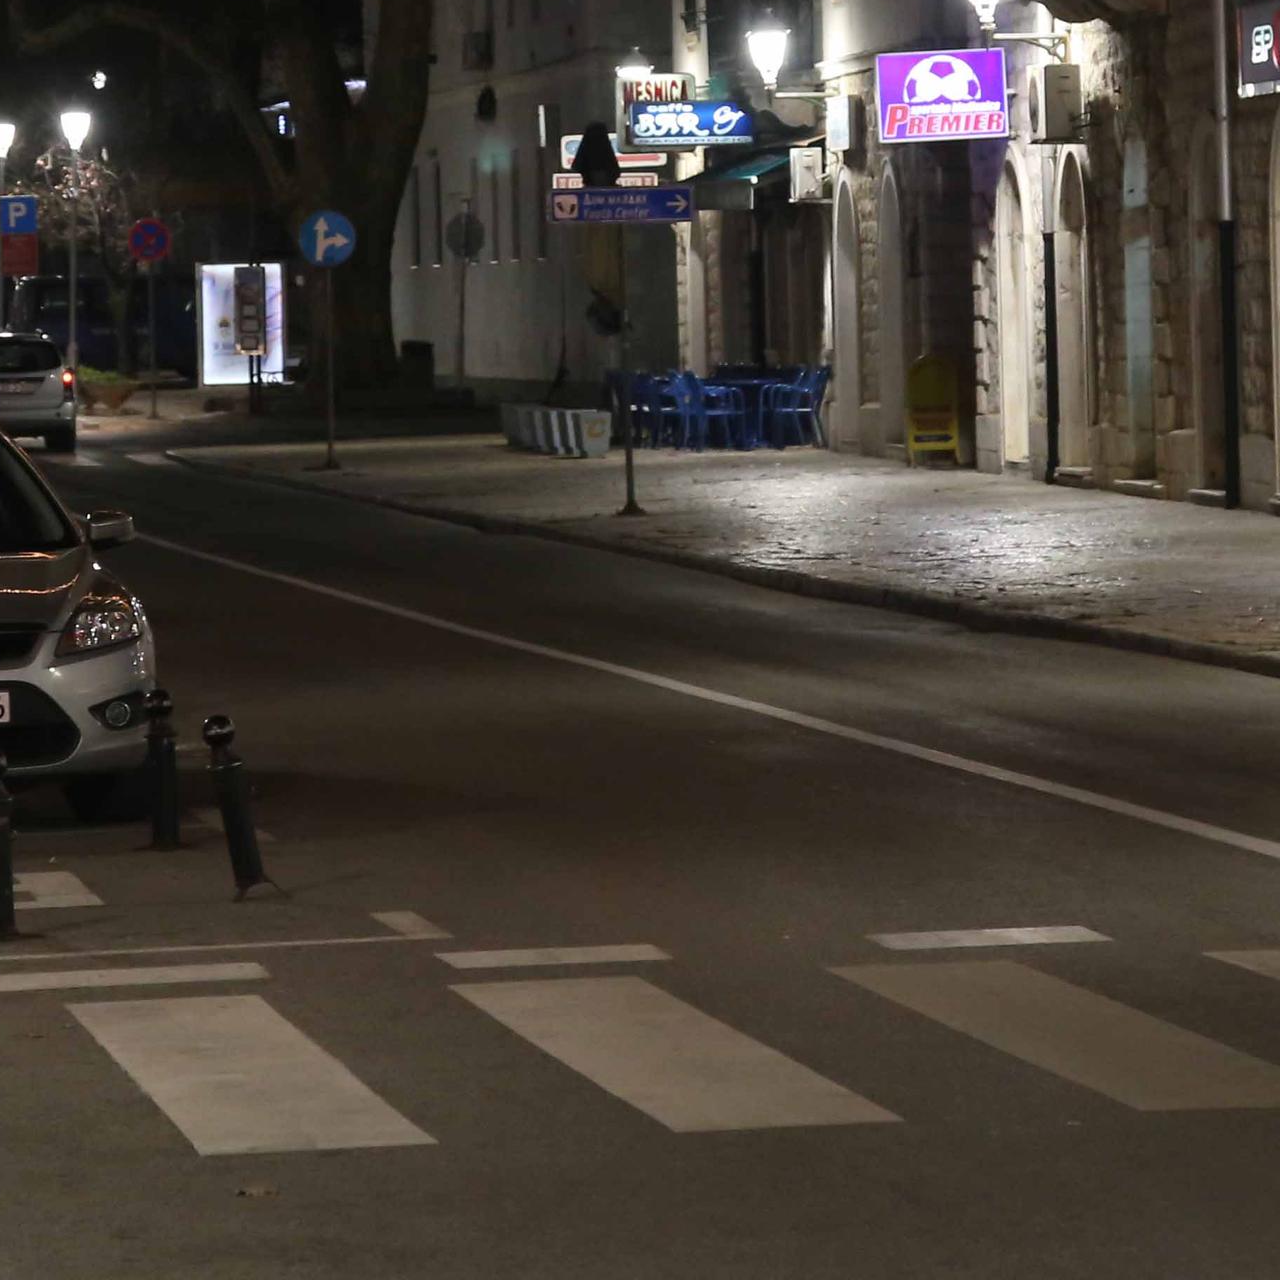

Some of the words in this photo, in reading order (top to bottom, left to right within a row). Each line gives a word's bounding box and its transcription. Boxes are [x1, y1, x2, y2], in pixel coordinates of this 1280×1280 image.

[633, 112, 710, 137] BAR
[884, 104, 1004, 137] PREMIER
[8, 201, 27, 227] P
